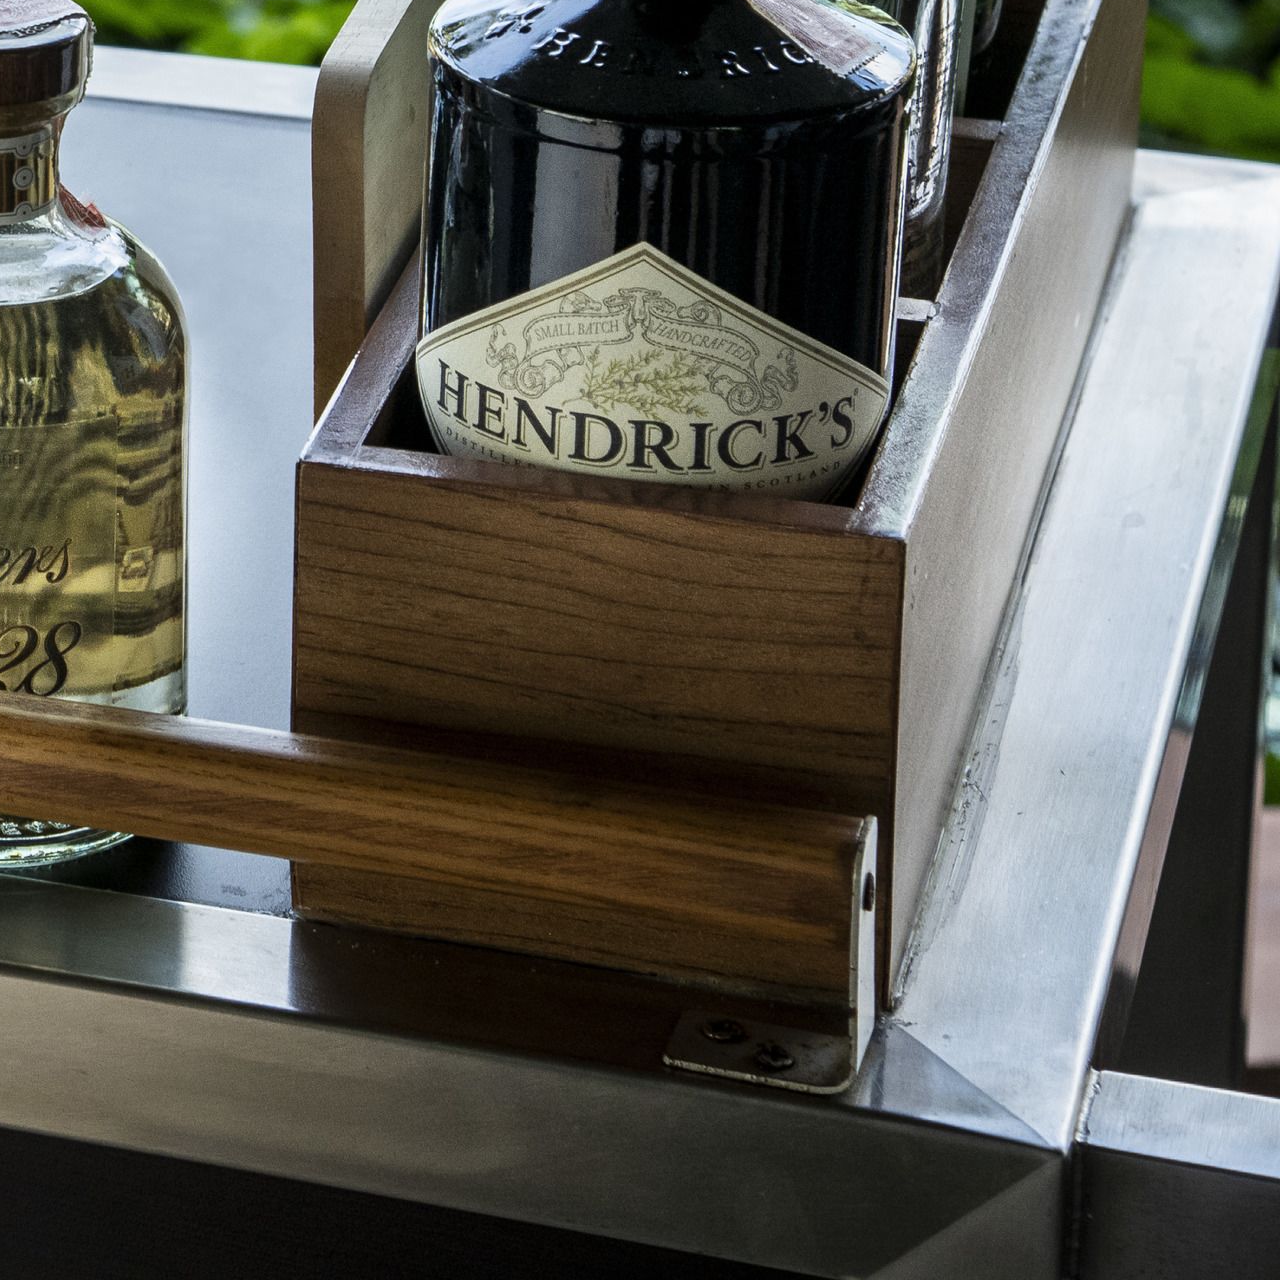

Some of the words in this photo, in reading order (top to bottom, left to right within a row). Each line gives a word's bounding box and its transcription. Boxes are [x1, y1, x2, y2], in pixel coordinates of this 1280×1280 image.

[534, 323, 575, 341] SMALL
[577, 321, 620, 337] BATCH
[651, 320, 752, 364] HANDCRAFTED
[437, 357, 856, 476] HENDRICK'S
[743, 461, 842, 493] SCOTLAND
